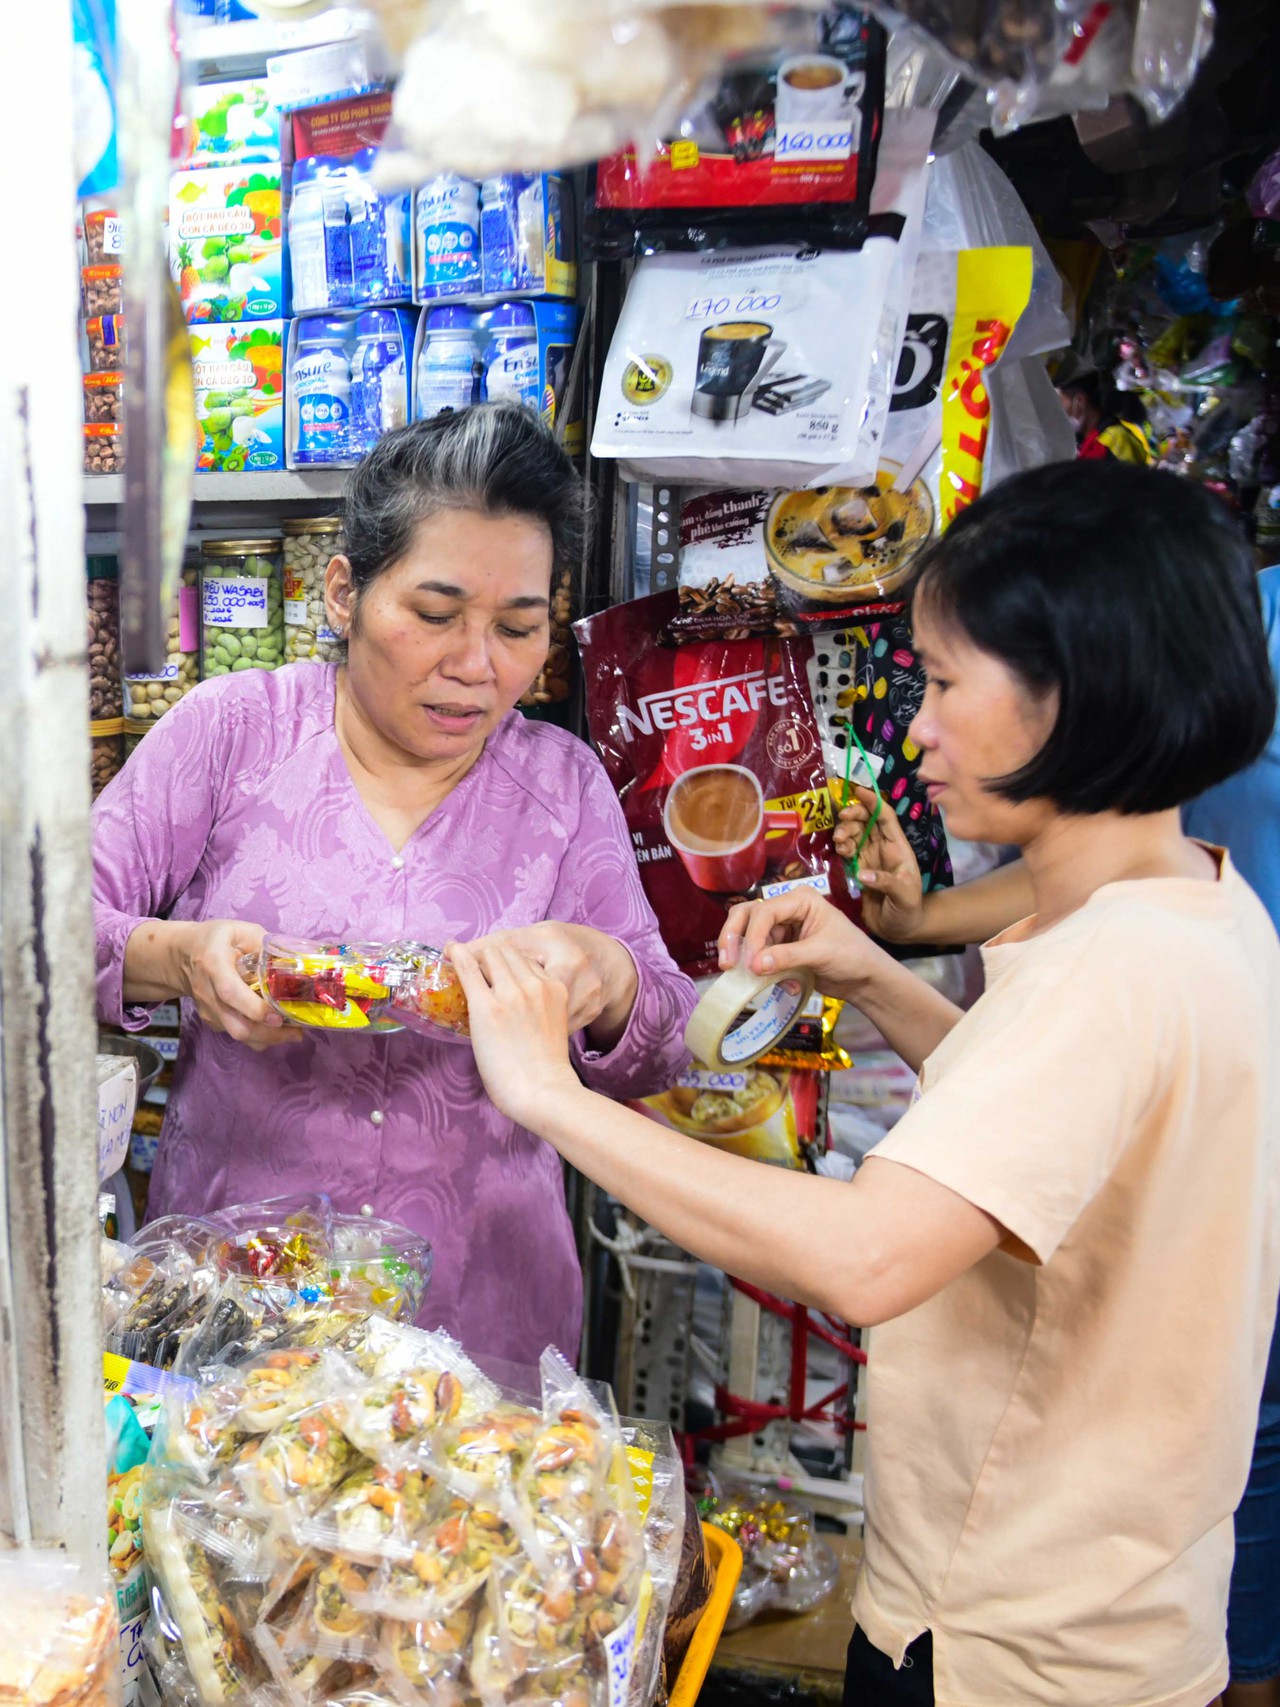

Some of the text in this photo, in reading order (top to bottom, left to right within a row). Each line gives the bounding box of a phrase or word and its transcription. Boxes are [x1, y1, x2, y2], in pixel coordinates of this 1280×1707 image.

[686, 294, 781, 319] 170.000
[194, 363, 206, 374] ỘT
[295, 361, 332, 380] nsure
[723, 495, 760, 514] thanh
[801, 794, 826, 823] 24
